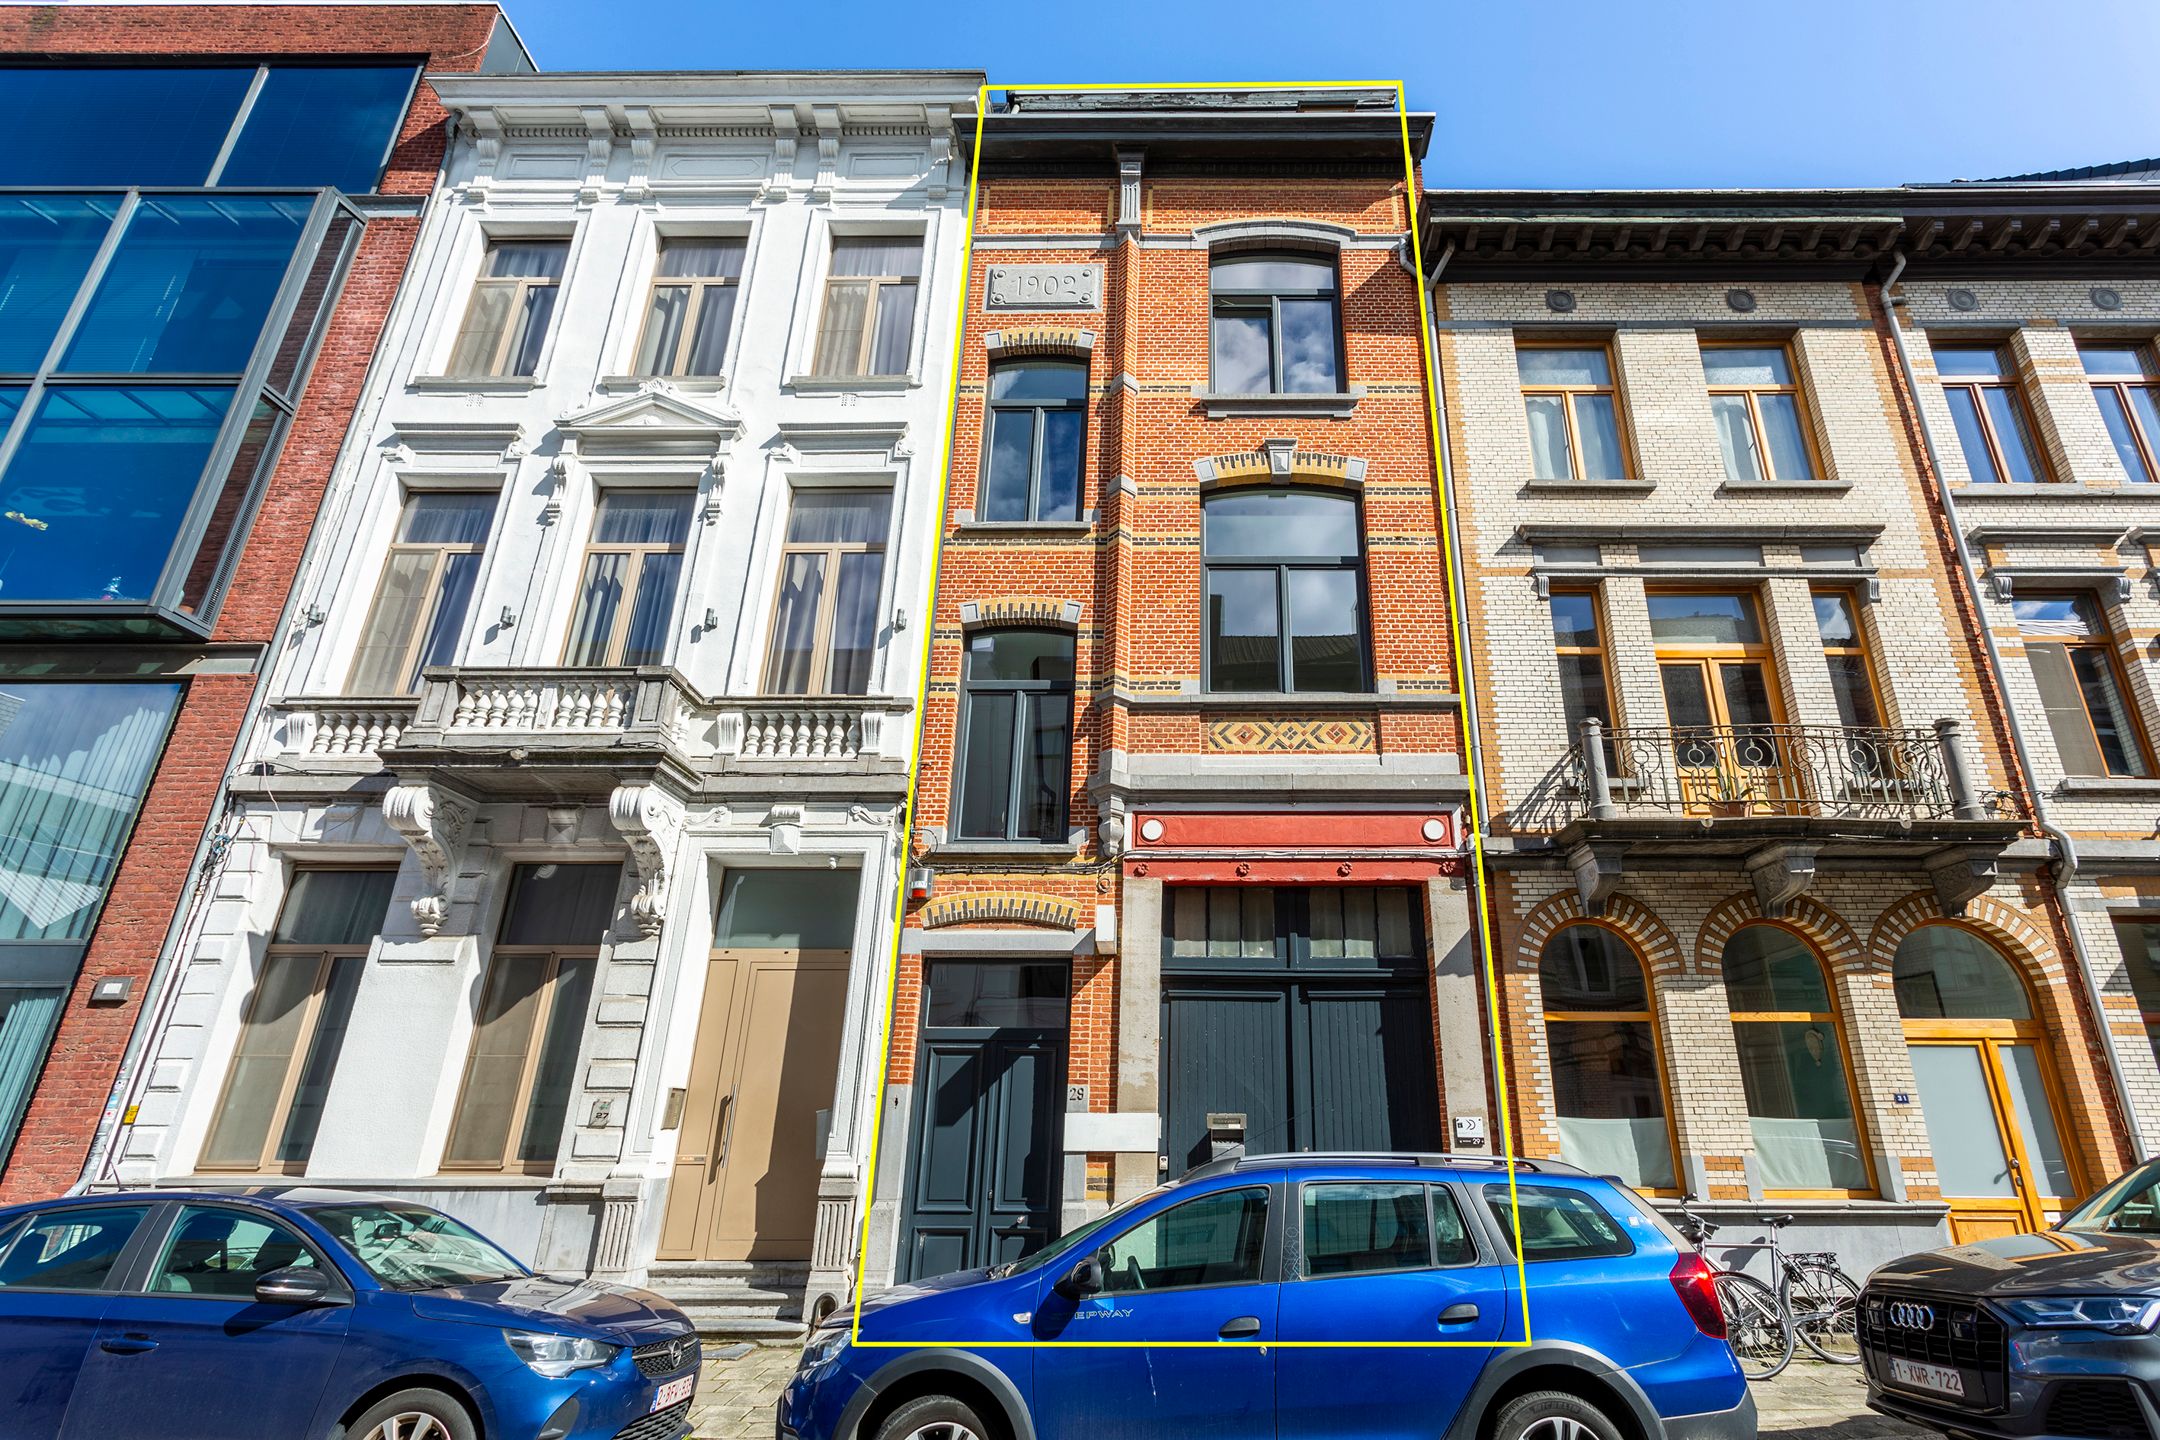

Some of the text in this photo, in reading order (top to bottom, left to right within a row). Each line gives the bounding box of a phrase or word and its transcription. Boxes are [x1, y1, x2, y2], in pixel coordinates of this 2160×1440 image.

[1017, 275, 1077, 298] 1902
[1069, 1087, 1084, 1101] 29
[1052, 1308, 1133, 1320] EPWAY
[1895, 1362, 1961, 1391] 1-XWR-722
